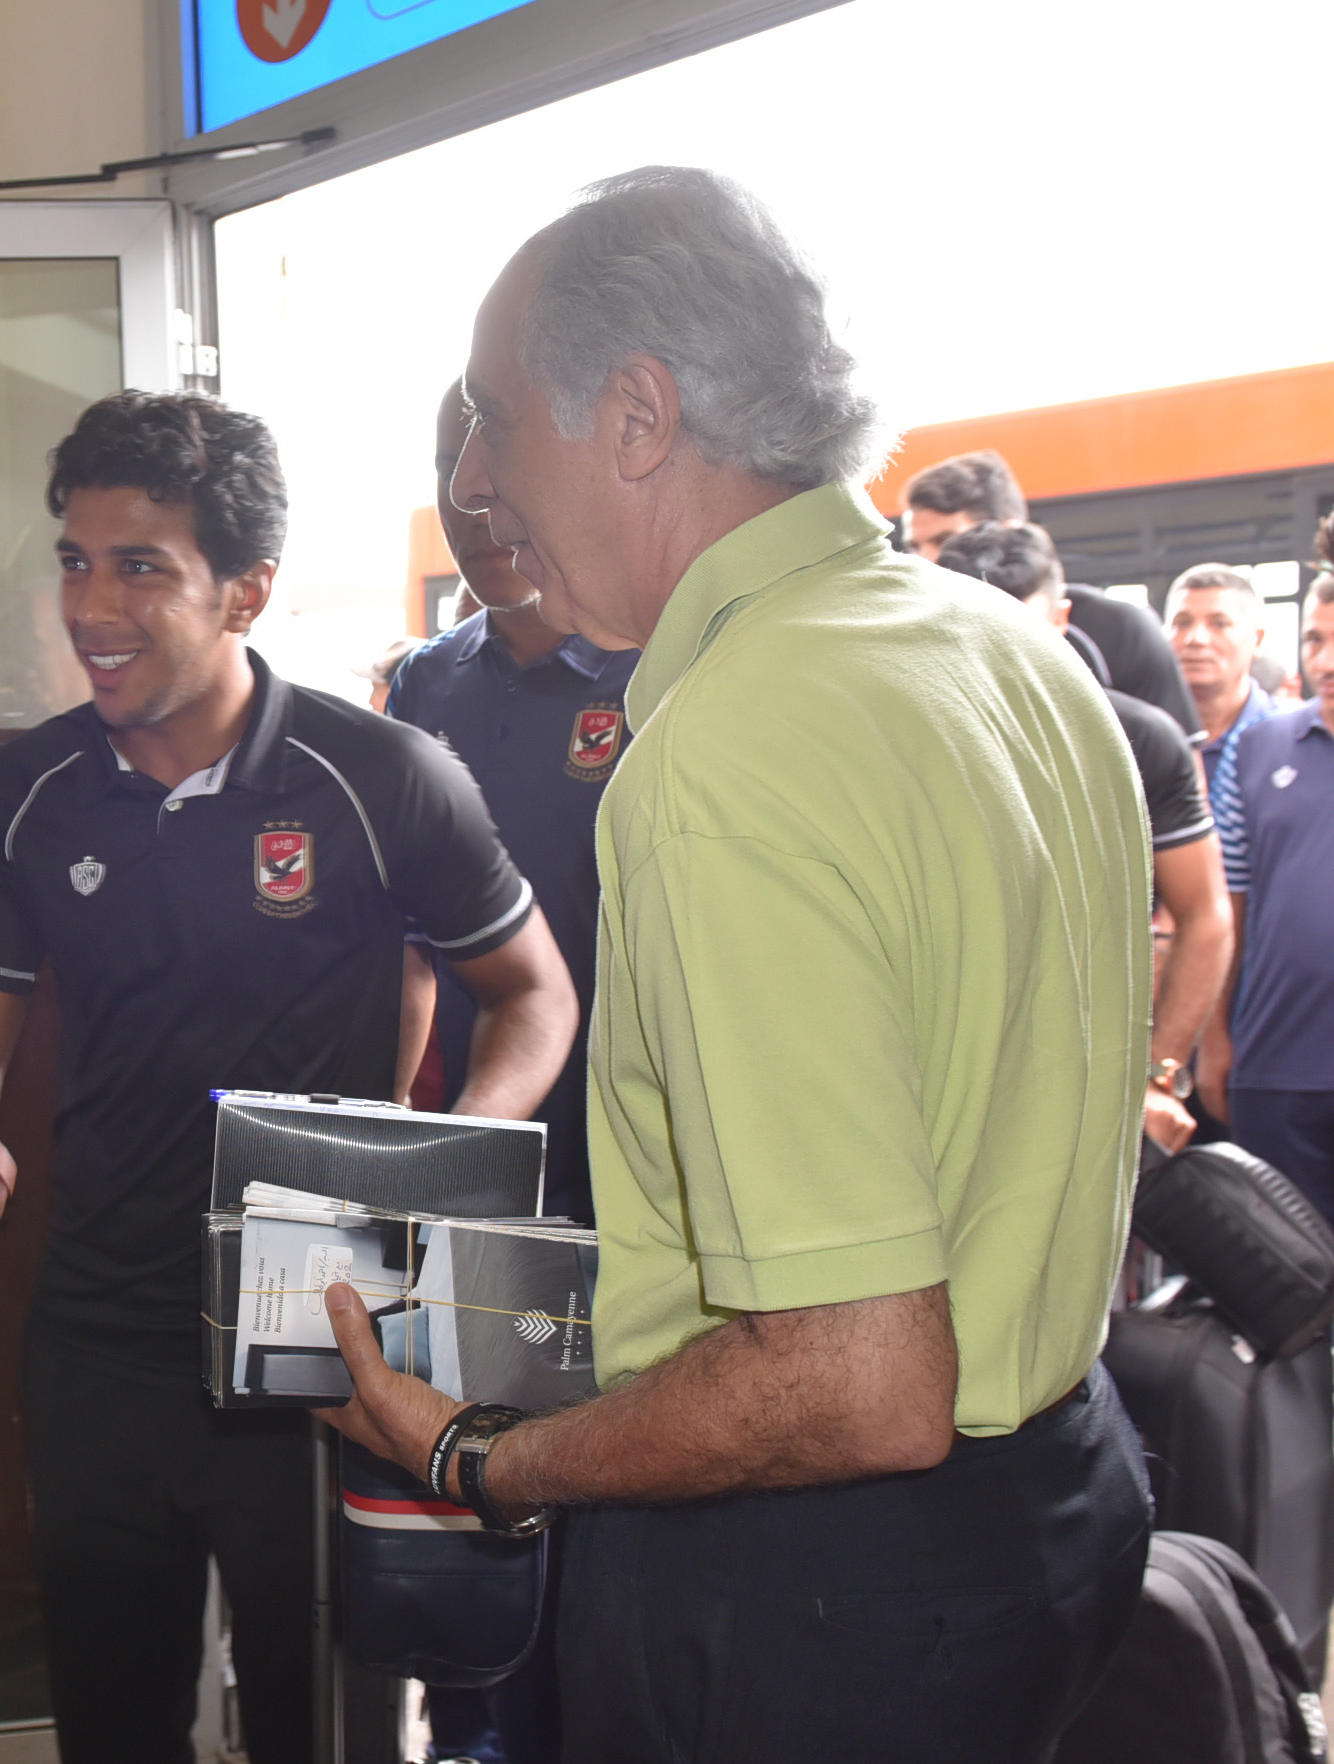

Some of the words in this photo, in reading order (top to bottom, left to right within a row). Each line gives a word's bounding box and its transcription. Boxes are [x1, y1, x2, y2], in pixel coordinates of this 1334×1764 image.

[253, 1293, 263, 1332] Bienvenue
[264, 1300, 272, 1332] Welcome
[559, 1347, 571, 1371] Palm
[439, 1424, 458, 1451] SPORTS
